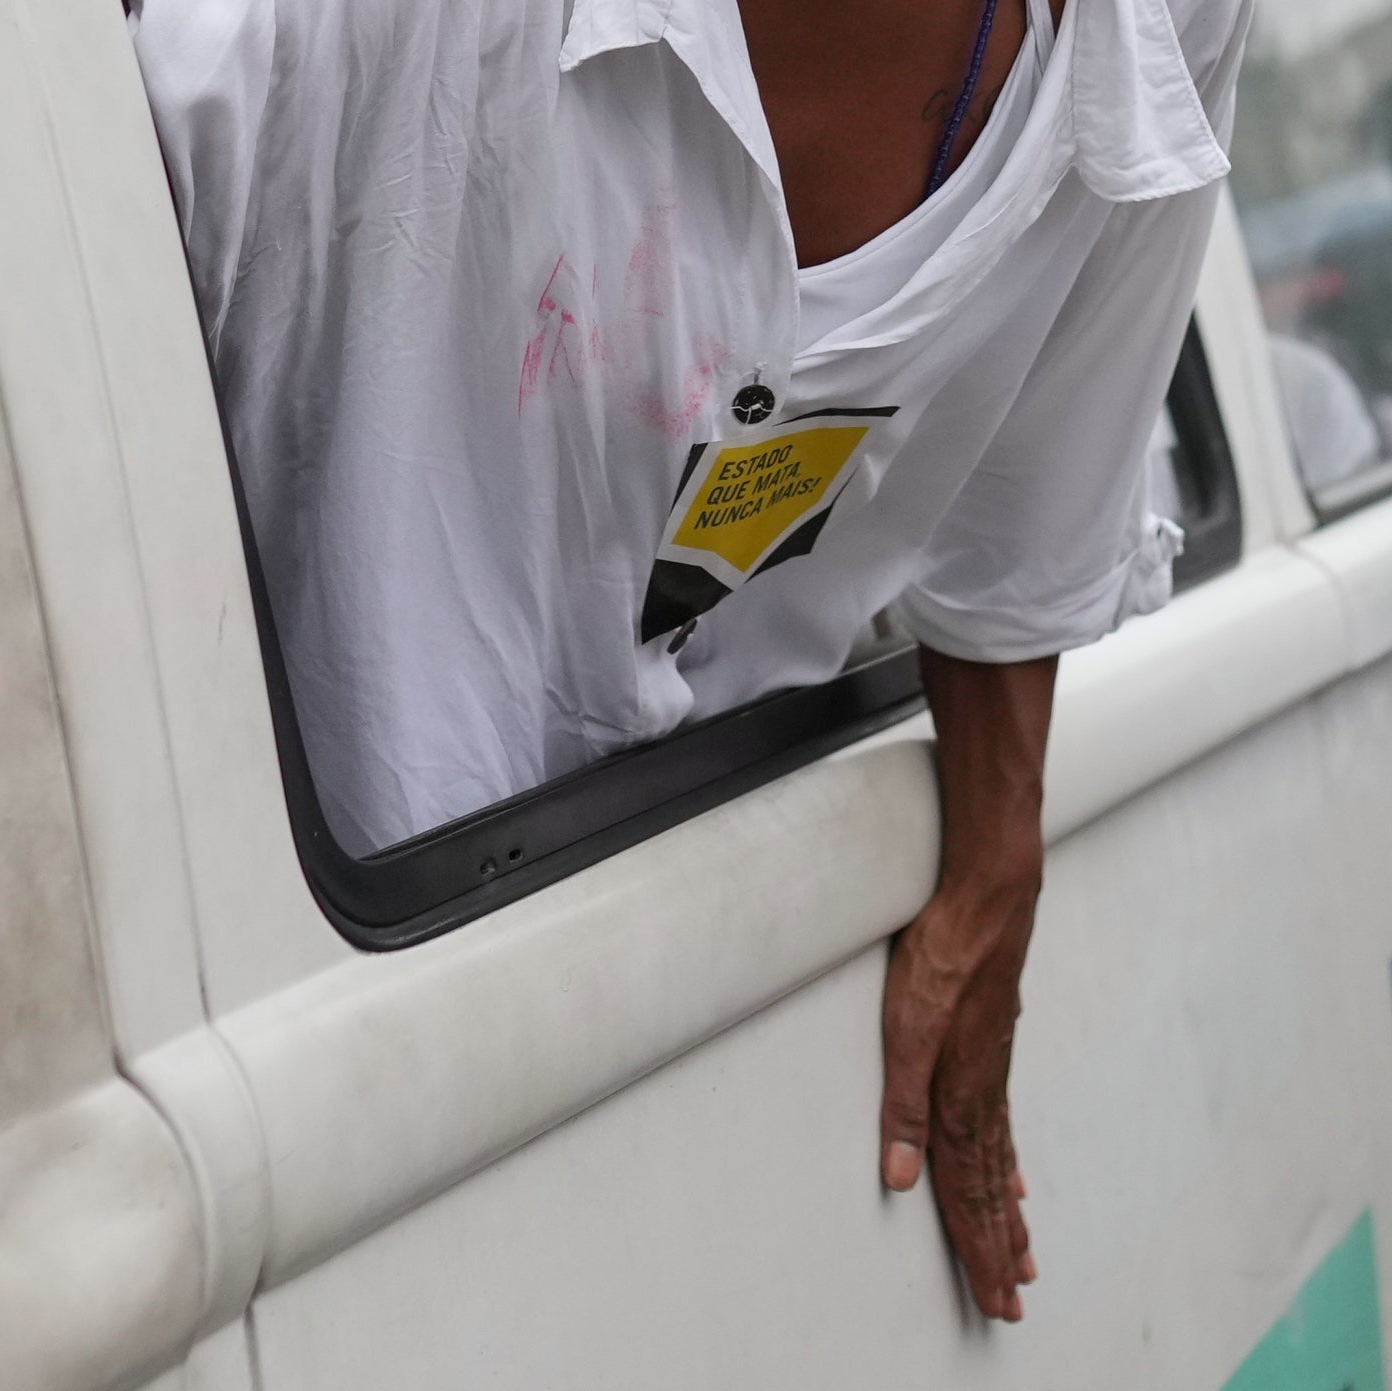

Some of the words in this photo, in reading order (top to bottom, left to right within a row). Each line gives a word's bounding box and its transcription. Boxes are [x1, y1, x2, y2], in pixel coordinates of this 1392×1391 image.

[718, 444, 793, 481] ESTADO
[694, 497, 764, 530] NUNCA
[765, 476, 823, 508] MAIS!
[707, 480, 751, 505] QUE
